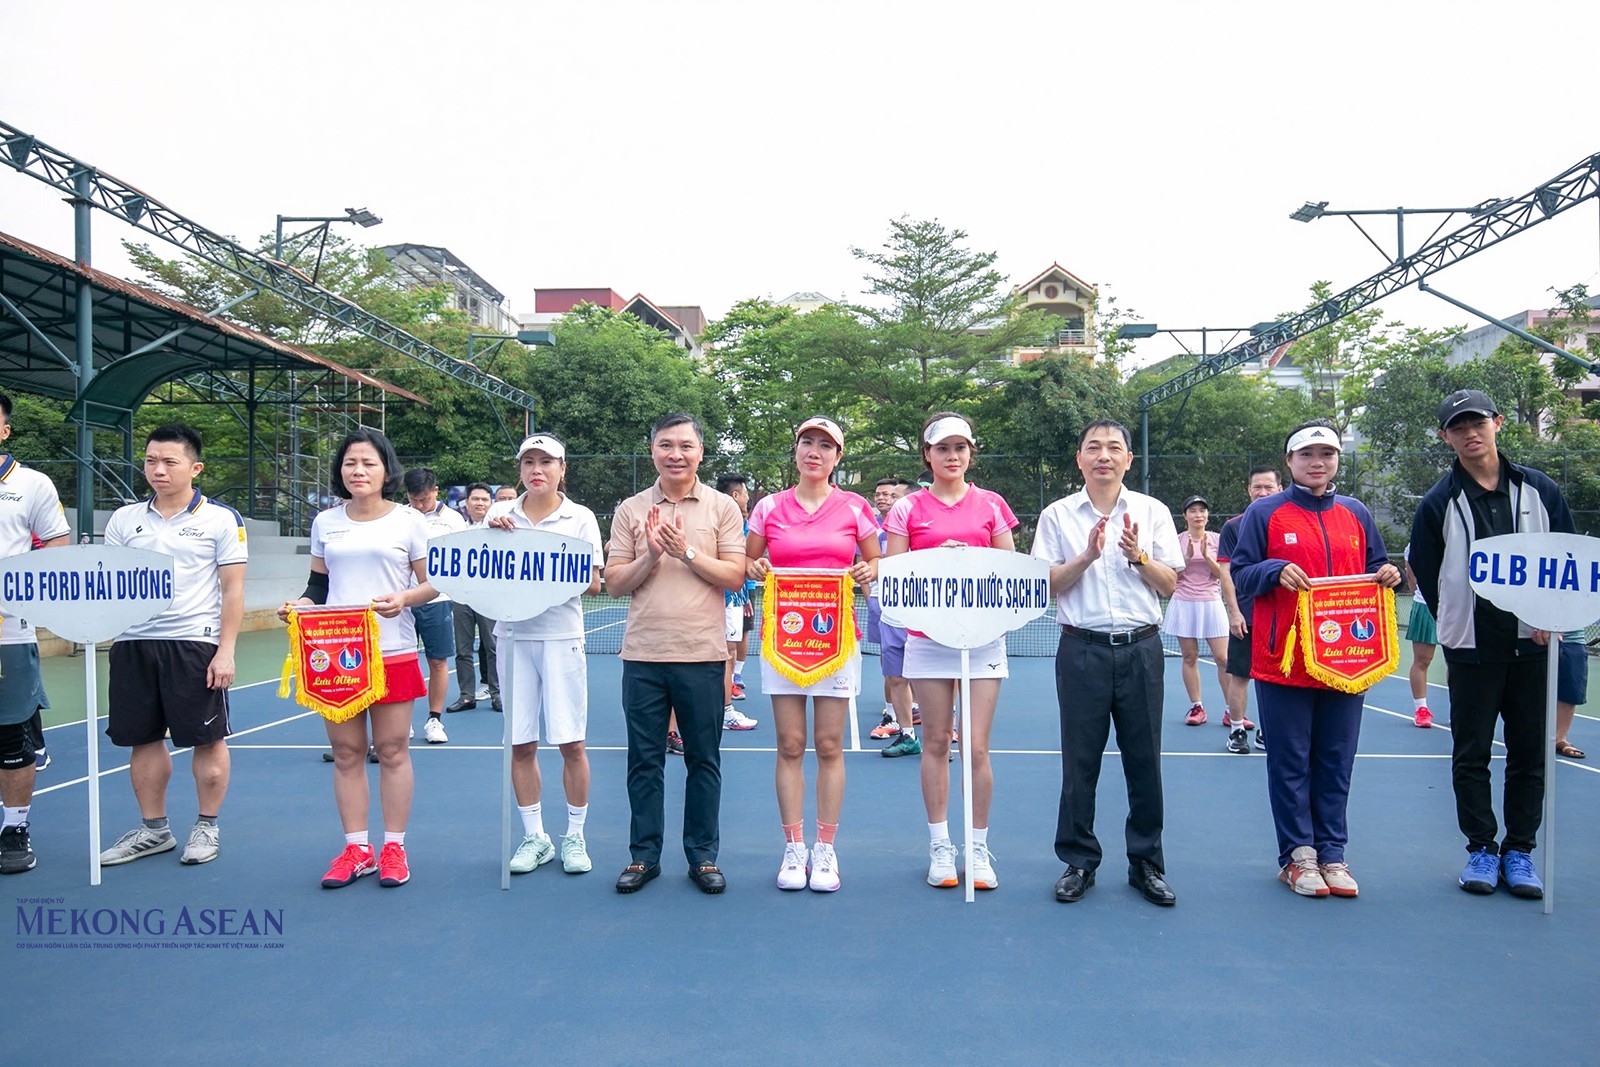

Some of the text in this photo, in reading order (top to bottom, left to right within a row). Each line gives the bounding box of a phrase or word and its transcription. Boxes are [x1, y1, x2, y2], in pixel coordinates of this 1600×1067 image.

[179, 527, 204, 537] Ford
[4, 561, 171, 601] CLB FORD HẢI DƯƠNG
[428, 542, 591, 583] CLB CÔNG AN TỈNH
[1470, 552, 1527, 586] CLB
[1538, 552, 1579, 591] HÀ
[882, 571, 1047, 614] CLB CÔNG TY CP KD NƯỚC SẠCH HD
